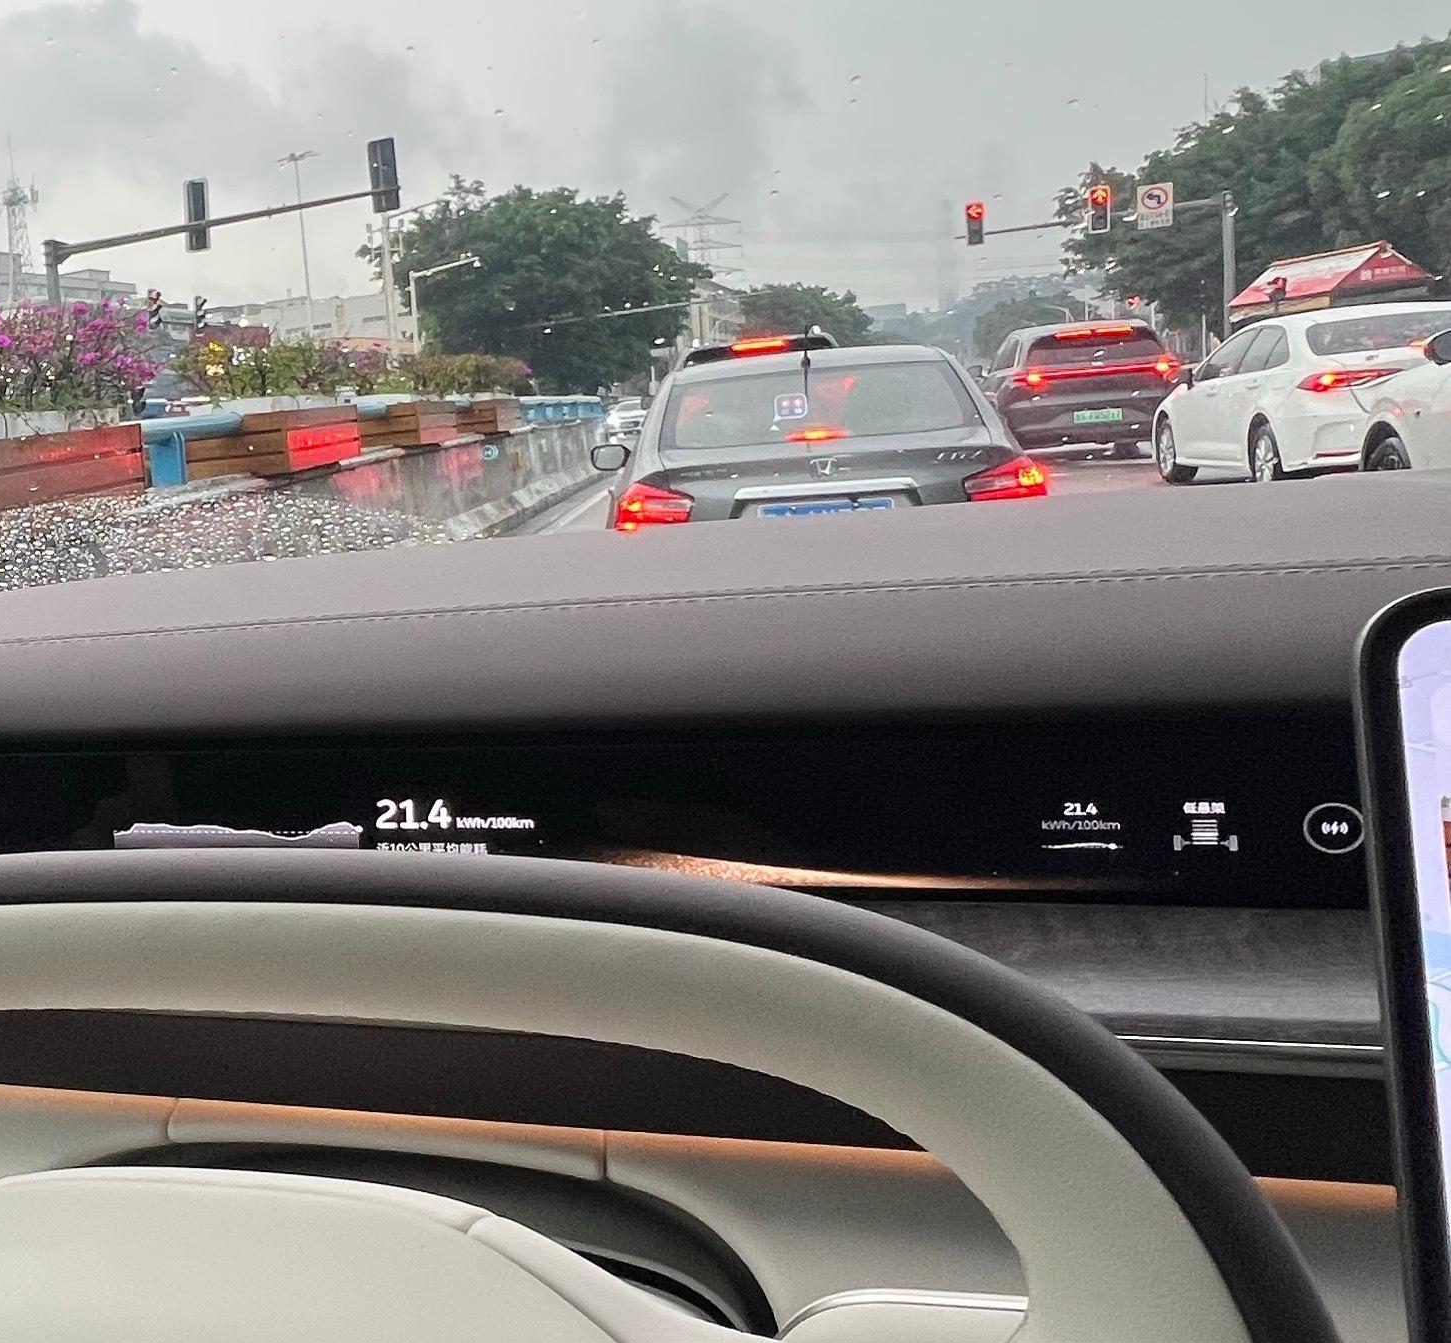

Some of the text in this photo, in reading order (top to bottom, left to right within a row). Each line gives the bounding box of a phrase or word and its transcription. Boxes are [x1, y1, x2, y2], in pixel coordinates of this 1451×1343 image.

[376, 798, 535, 830] 21.4 kWh/100km
[1063, 802, 1098, 816] 21.4
[1041, 820, 1121, 831] kWh/100km
